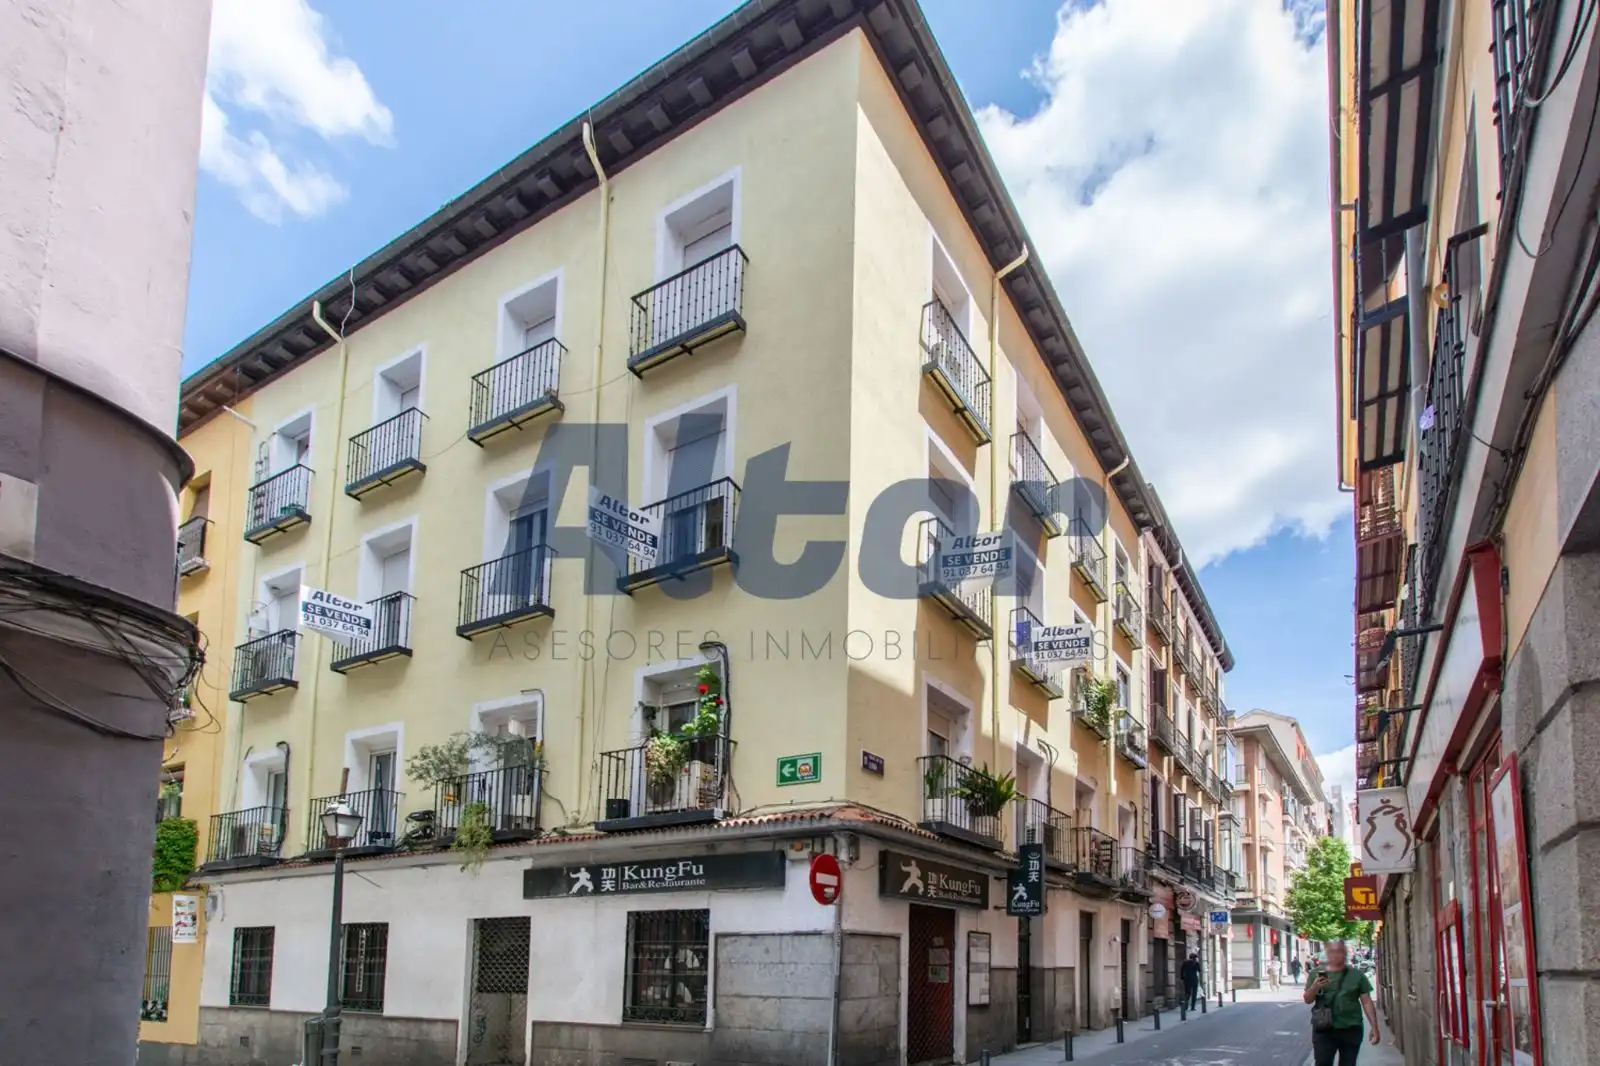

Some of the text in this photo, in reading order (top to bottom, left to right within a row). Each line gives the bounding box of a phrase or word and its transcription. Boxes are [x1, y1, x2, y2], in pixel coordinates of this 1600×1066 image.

[599, 495, 650, 524] Altor
[594, 510, 653, 546] SE VENDE
[590, 522, 602, 536] 91
[605, 532, 626, 545] 037
[628, 539, 641, 553] 64
[643, 546, 656, 559] 94
[952, 535, 1003, 550] Altor
[947, 549, 1006, 566] SE VENDE
[943, 568, 957, 578] 91
[959, 565, 978, 577] 037
[980, 563, 994, 574] 64
[312, 591, 363, 611] Altor
[306, 603, 368, 628] SE VENDE
[303, 612, 316, 624] 91
[319, 617, 339, 629] 037
[342, 623, 355, 633] 64
[357, 627, 370, 638] 94
[1041, 626, 1082, 637] Altor
[1038, 639, 1086, 650] SE VENDE
[1034, 651, 1045, 660] 91
[1047, 651, 1062, 659] 037
[623, 861, 704, 881] KungFu
[622, 878, 706, 890] Bar&Restaurante
[939, 873, 981, 896] KungFu
[1011, 899, 1041, 909] KungFu
